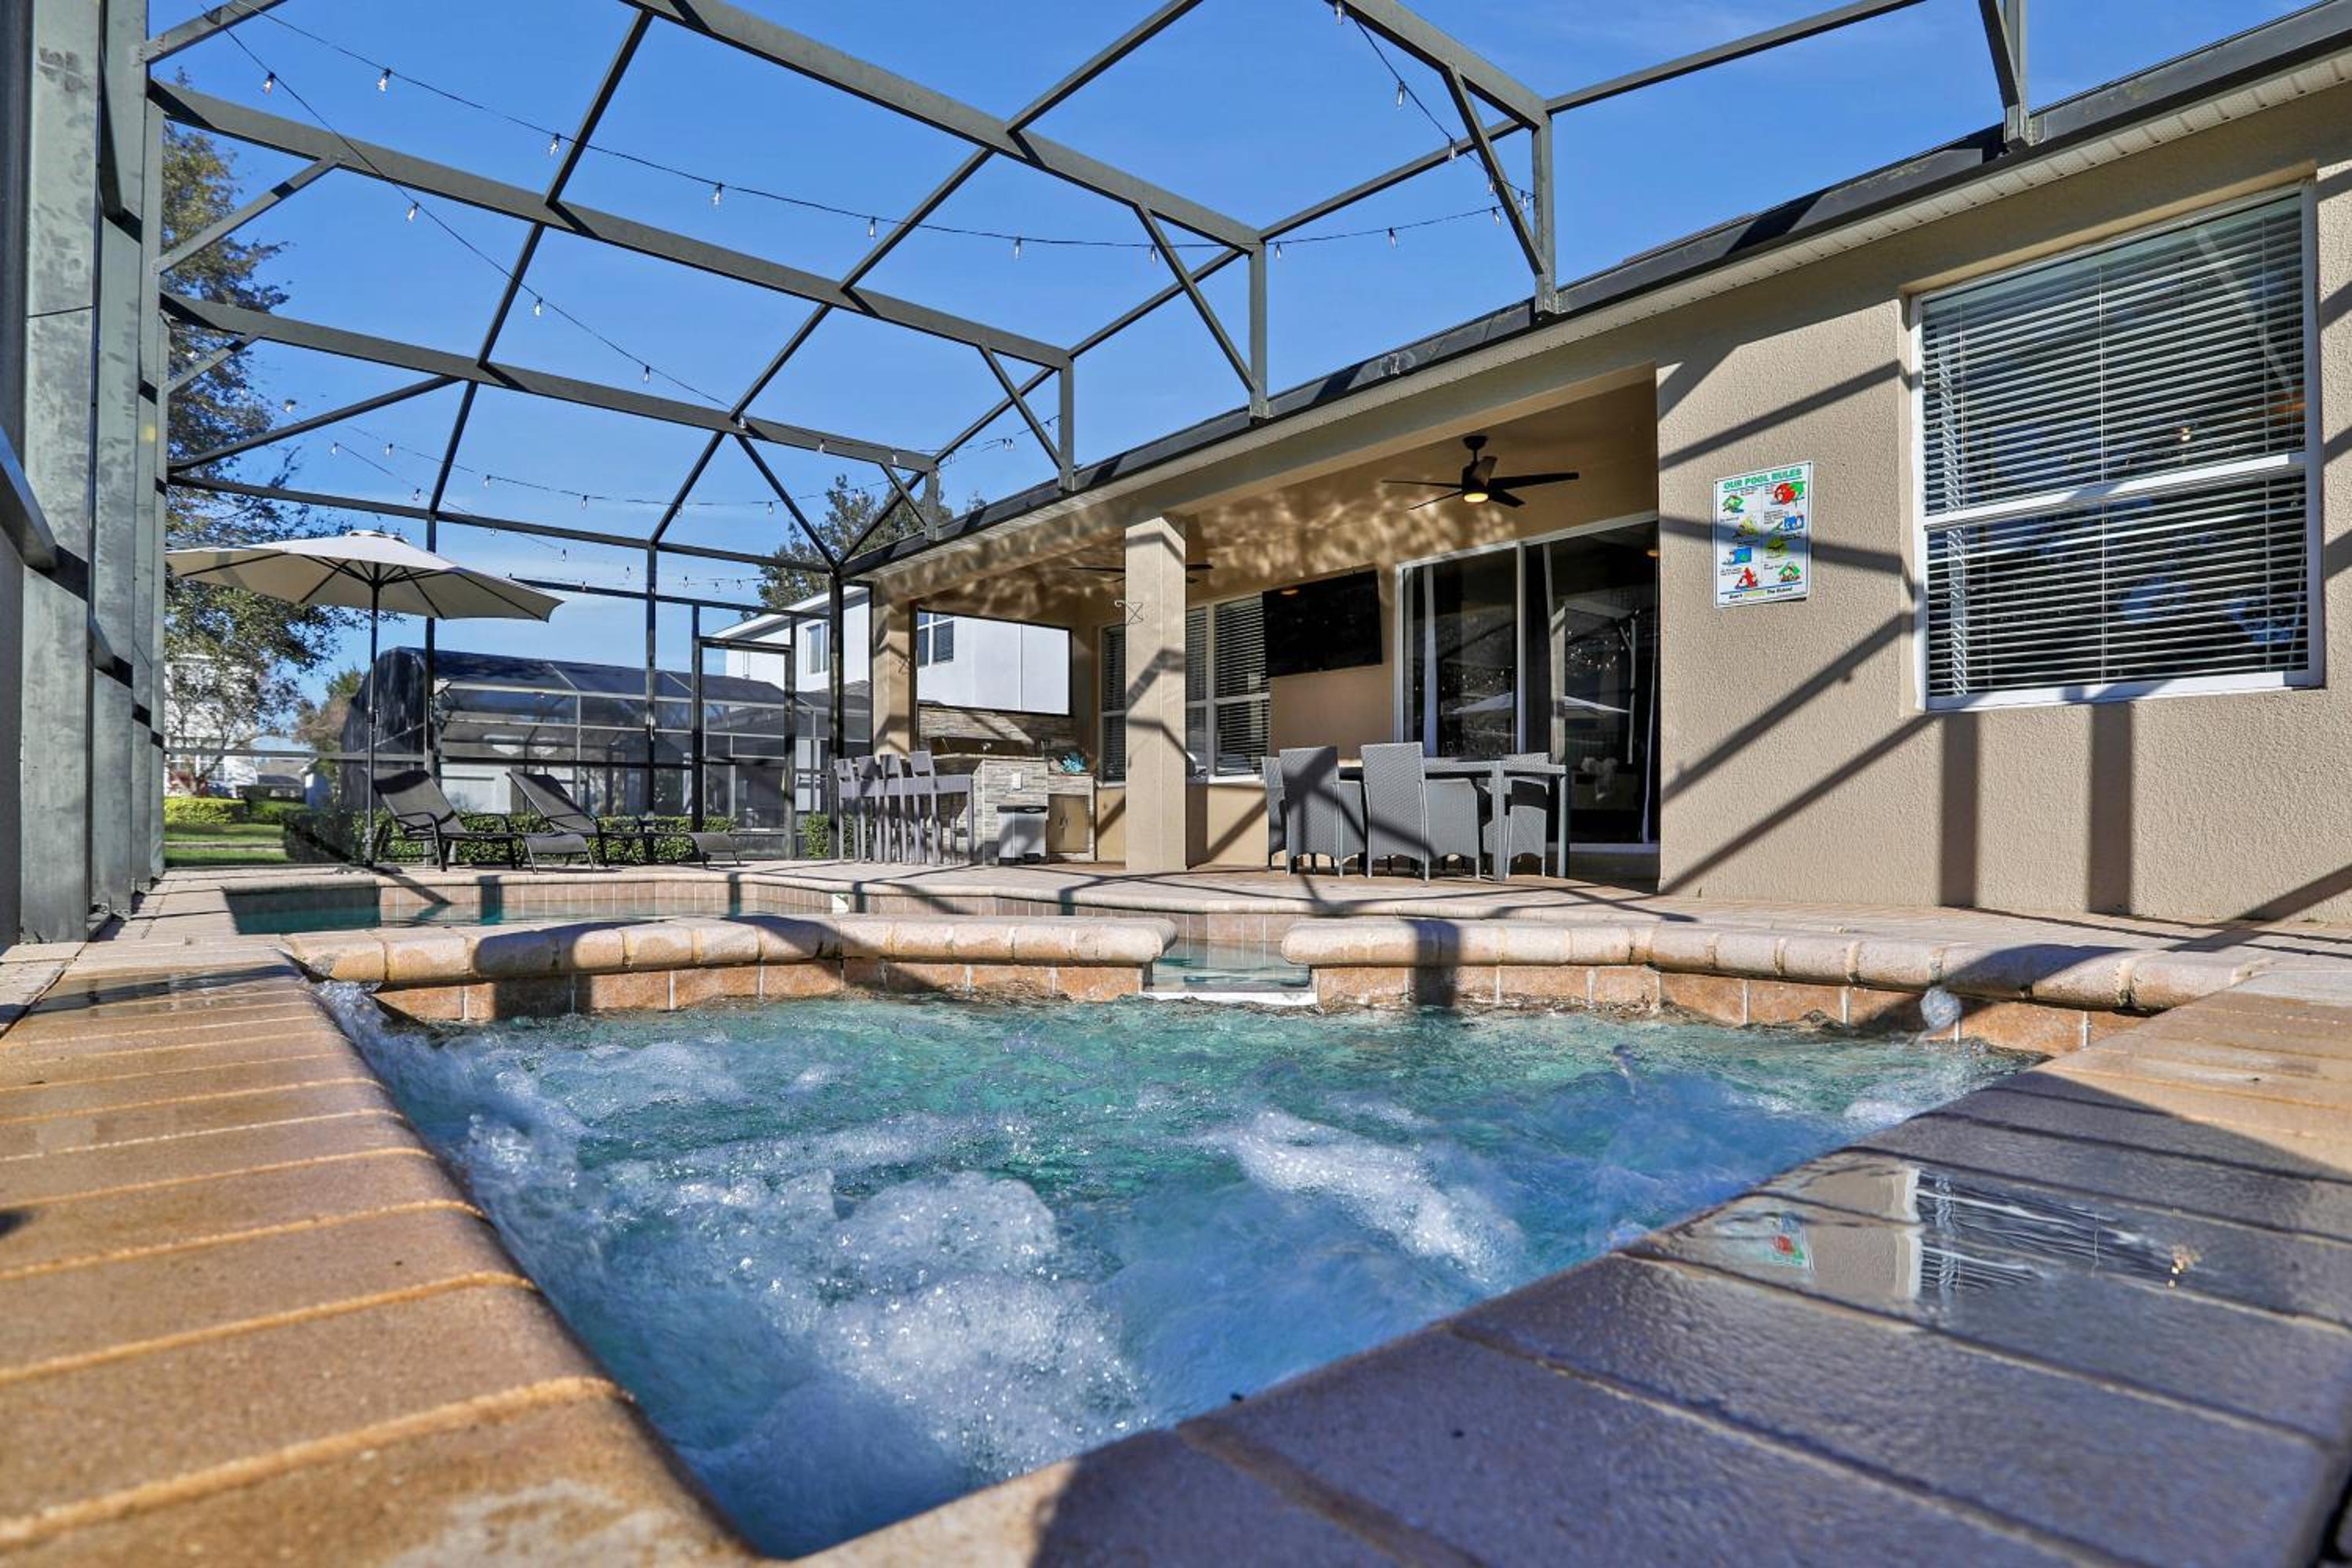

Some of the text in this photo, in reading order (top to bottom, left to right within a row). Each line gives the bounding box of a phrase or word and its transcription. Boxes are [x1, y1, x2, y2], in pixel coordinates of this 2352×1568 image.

[1724, 468, 1802, 489] OUR POOL RULES
